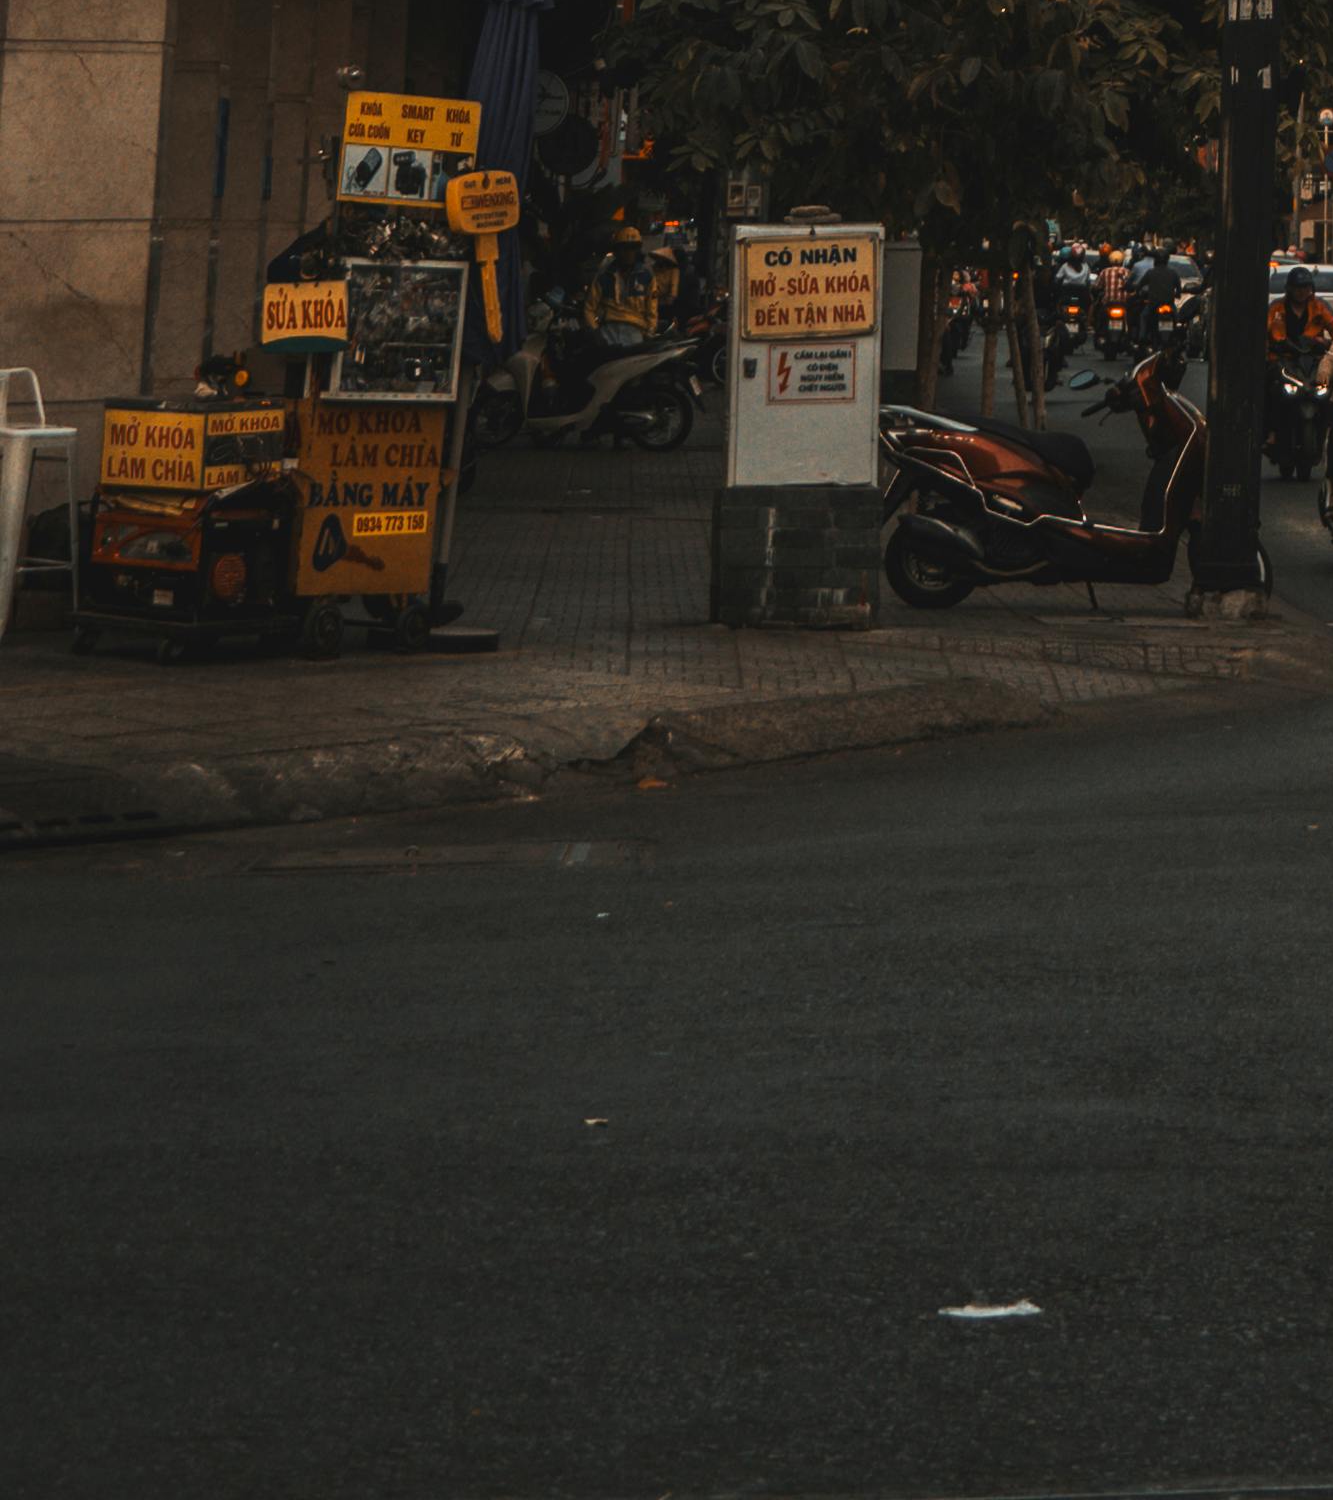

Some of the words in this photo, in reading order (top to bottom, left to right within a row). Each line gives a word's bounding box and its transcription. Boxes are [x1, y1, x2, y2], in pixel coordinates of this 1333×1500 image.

[360, 101, 382, 116] KHÓA
[402, 104, 434, 121] SMART
[446, 108, 470, 124] KHÓA
[407, 129, 425, 143] KEY
[764, 246, 792, 266] CÓ
[801, 244, 857, 267] NHẬN
[750, 272, 777, 297] MỞ
[787, 270, 819, 296] SỬA
[825, 270, 870, 294] KHÓA
[266, 287, 297, 330] SỬA
[302, 289, 346, 329] KHÓA
[755, 301, 789, 326] ĐẾN
[795, 302, 827, 328] TẬN
[833, 300, 866, 323] NHÀ
[111, 416, 140, 447] MỞ
[145, 420, 195, 450] KHÓA
[211, 413, 236, 433] MỞ
[239, 411, 280, 432] KHÓA
[329, 435, 379, 468] LÀM
[385, 438, 438, 469] CHÌA
[106, 451, 146, 480] LÀM
[151, 453, 195, 483] CHÌA
[307, 470, 374, 508] BẰNG
[381, 475, 430, 507] MÁY
[357, 515, 382, 532] 0934
[385, 514, 404, 531] 773
